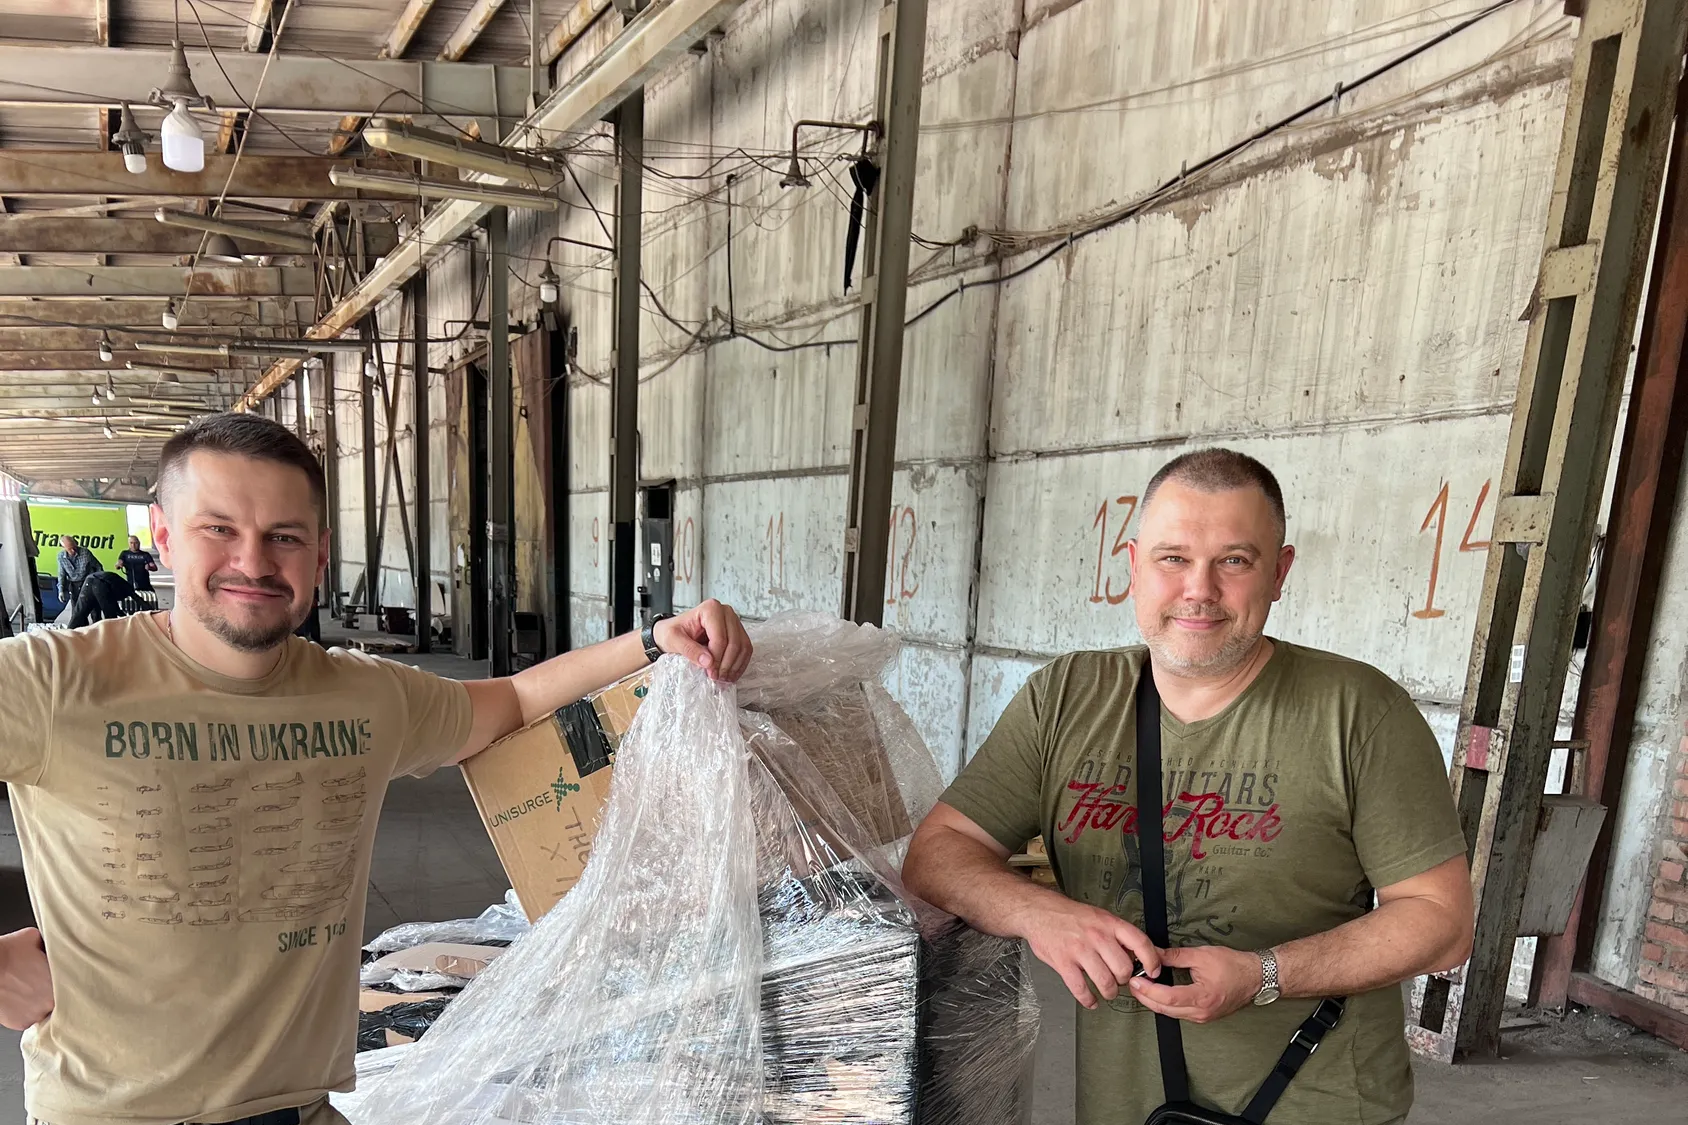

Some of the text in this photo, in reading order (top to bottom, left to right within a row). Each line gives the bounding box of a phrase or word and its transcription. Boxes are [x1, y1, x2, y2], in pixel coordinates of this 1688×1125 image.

[33, 530, 115, 549] Trasport
[674, 516, 695, 584] 10
[766, 512, 786, 594] 11
[886, 504, 919, 604] 12
[105, 718, 371, 762] BORN IN UKRAINE
[1162, 770, 1279, 806] UITARS
[489, 791, 553, 828] UNISURGE
[1163, 791, 1284, 860] Rock
[1212, 845, 1250, 856] Guitar
[1195, 878, 1211, 898] 71
[278, 926, 317, 953] SINCE
